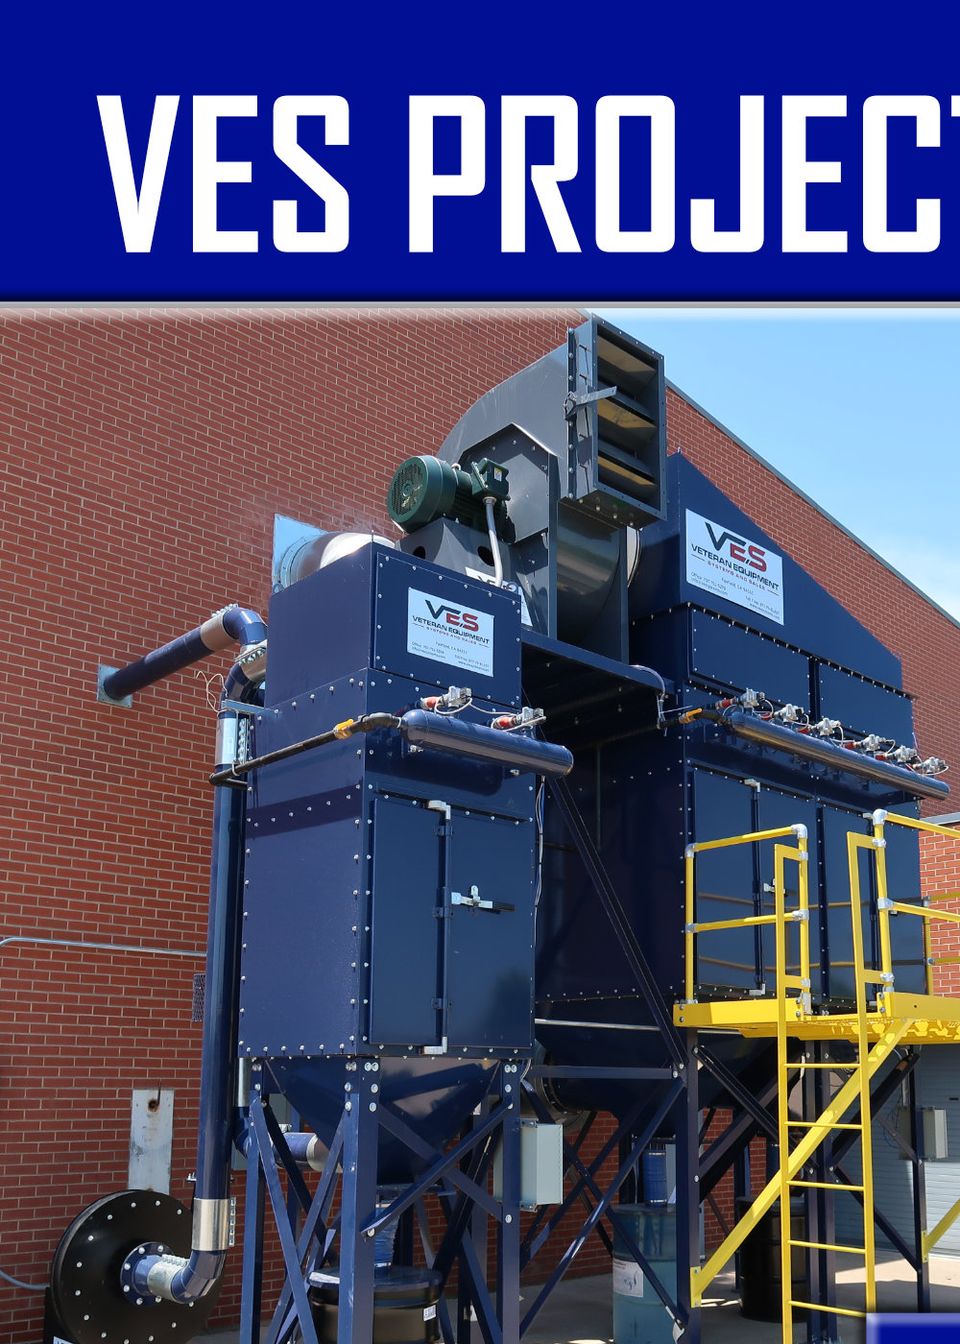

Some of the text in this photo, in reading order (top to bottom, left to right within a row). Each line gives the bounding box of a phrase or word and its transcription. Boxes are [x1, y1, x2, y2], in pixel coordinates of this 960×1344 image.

[704, 521, 767, 572] VES
[691, 543, 733, 569] VETERAN
[733, 562, 780, 591] EQUIPMENT
[412, 615, 490, 644] VETERAN EQUIPMENT
[424, 599, 479, 632] VES
